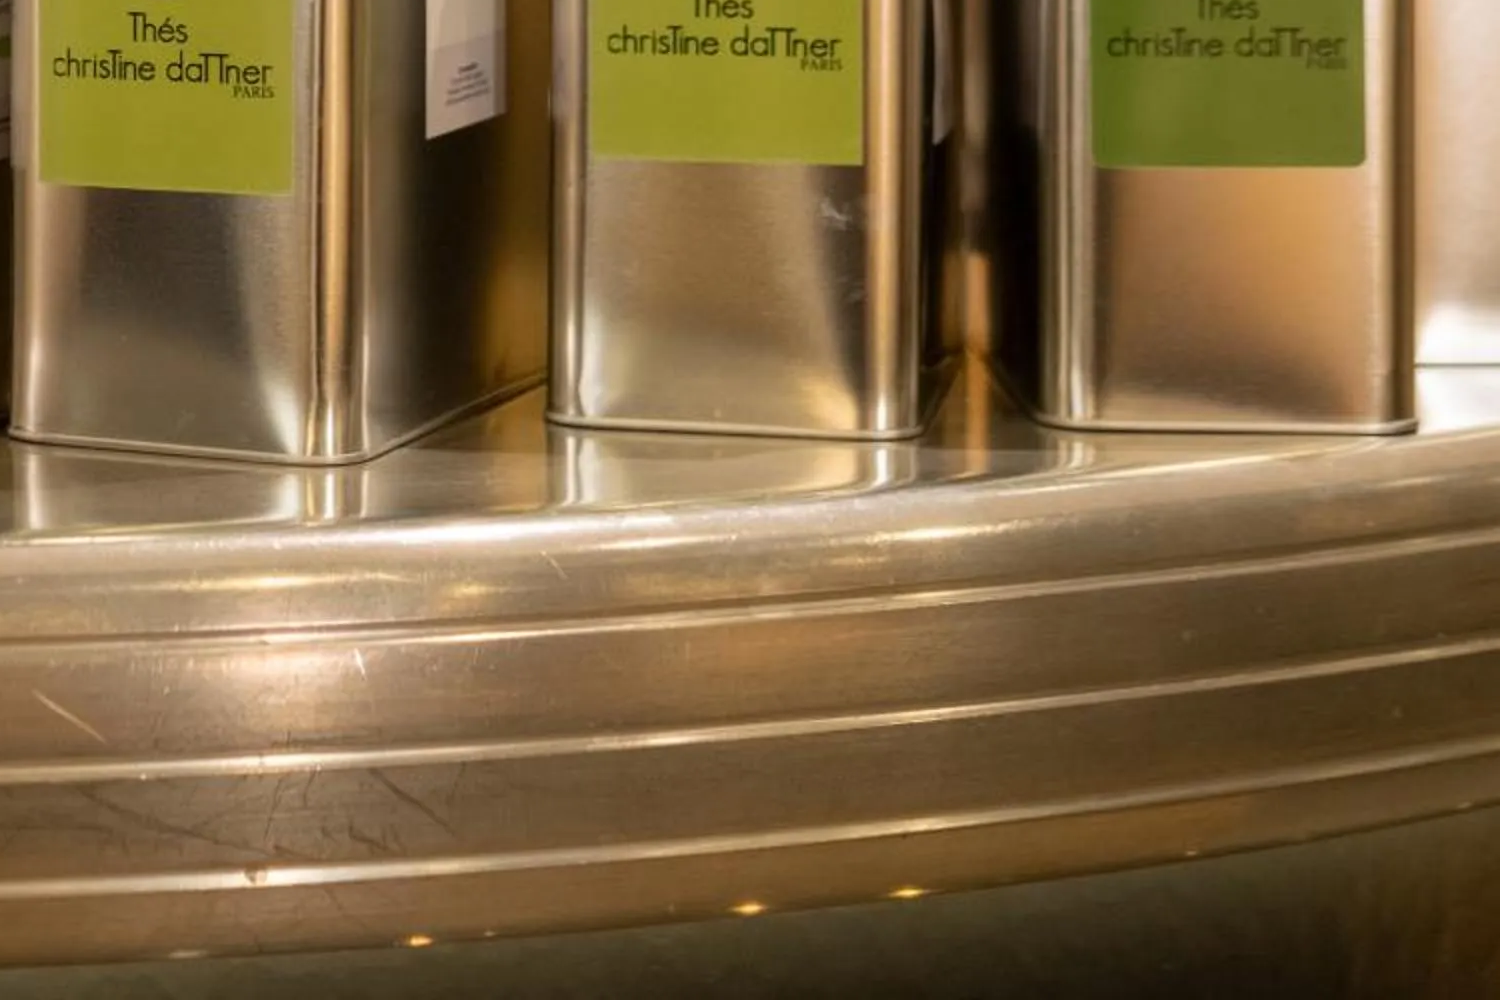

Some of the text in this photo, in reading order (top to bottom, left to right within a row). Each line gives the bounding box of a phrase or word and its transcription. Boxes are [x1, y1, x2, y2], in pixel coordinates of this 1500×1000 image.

[128, 12, 188, 43] Thés
[800, 58, 842, 71] PARIS
[233, 86, 274, 98] PARIS
